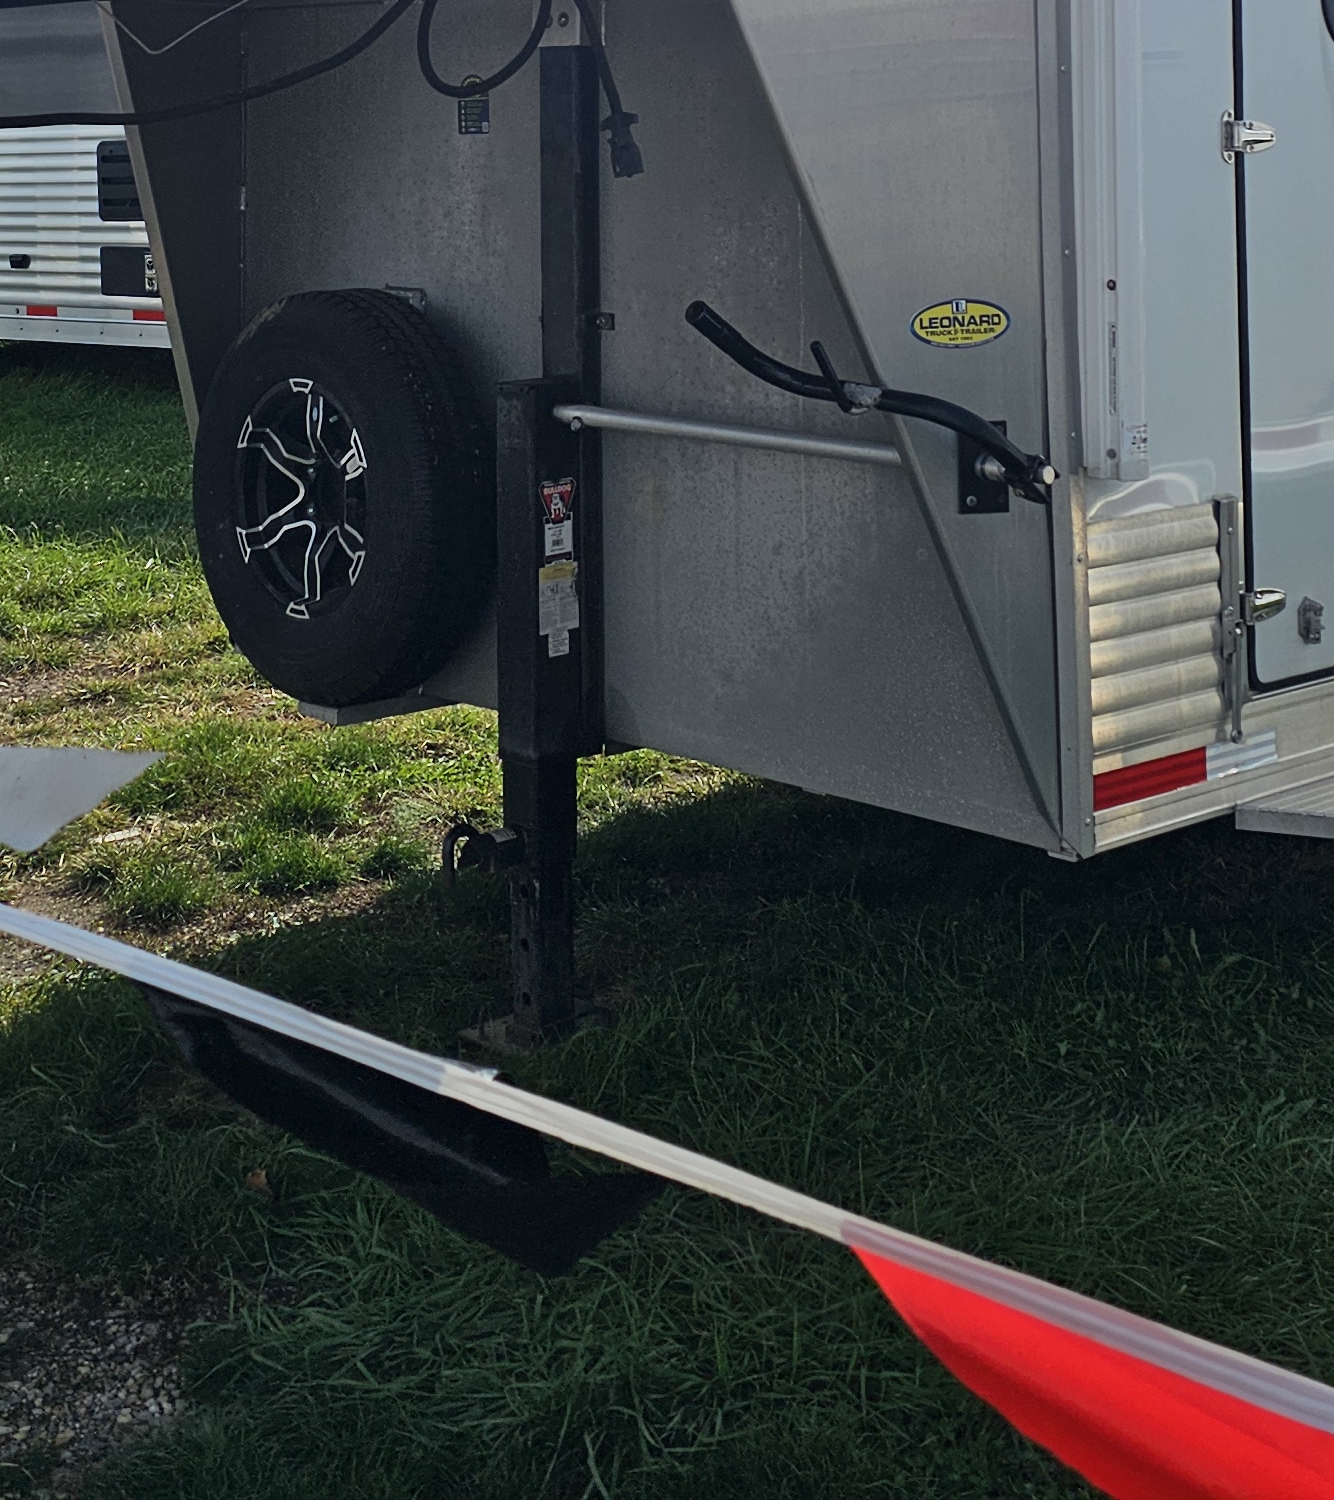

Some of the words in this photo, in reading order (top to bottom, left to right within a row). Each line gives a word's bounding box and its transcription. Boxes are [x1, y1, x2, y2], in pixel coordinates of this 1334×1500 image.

[919, 313, 1002, 330] LEONARD
[925, 328, 953, 337] TRUCK
[960, 327, 996, 335] TRAILER
[543, 484, 572, 496] BULLDOG
